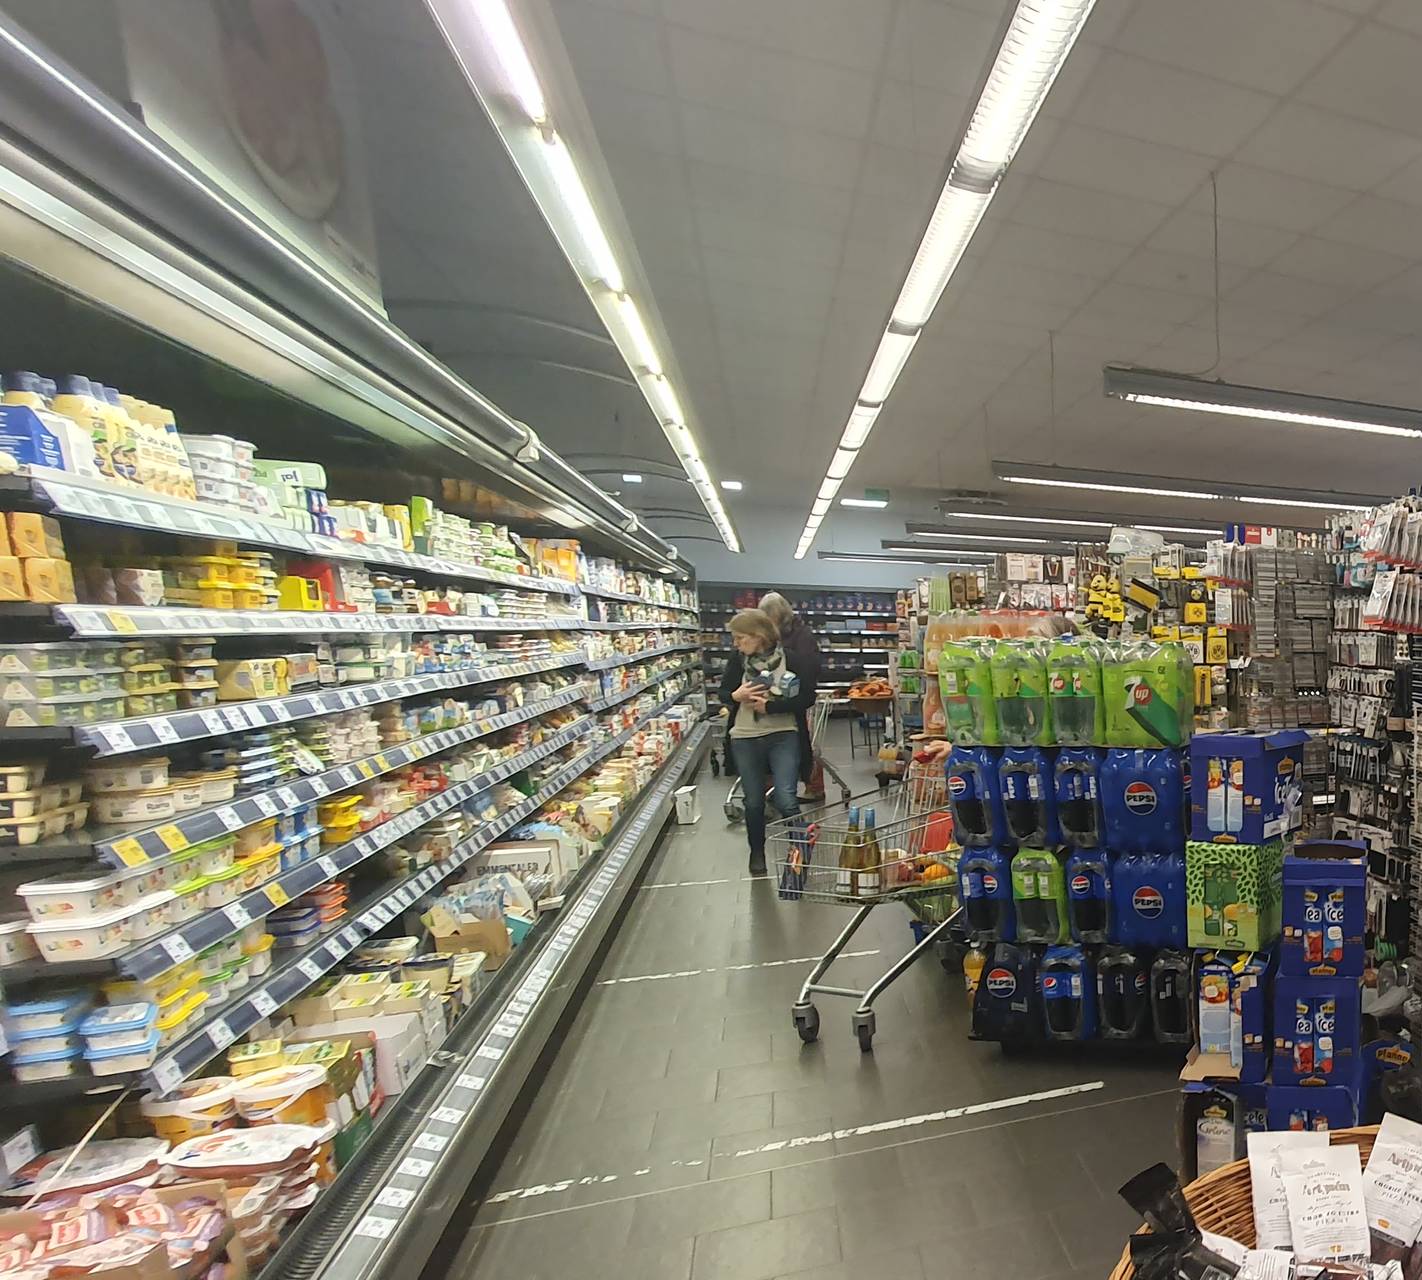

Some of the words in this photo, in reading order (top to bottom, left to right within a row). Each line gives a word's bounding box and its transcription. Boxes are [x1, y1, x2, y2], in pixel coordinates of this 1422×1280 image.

[1126, 794, 1155, 803] PEPSI
[1134, 898, 1162, 908] PEPSI
[987, 978, 1015, 988] PEPSI
